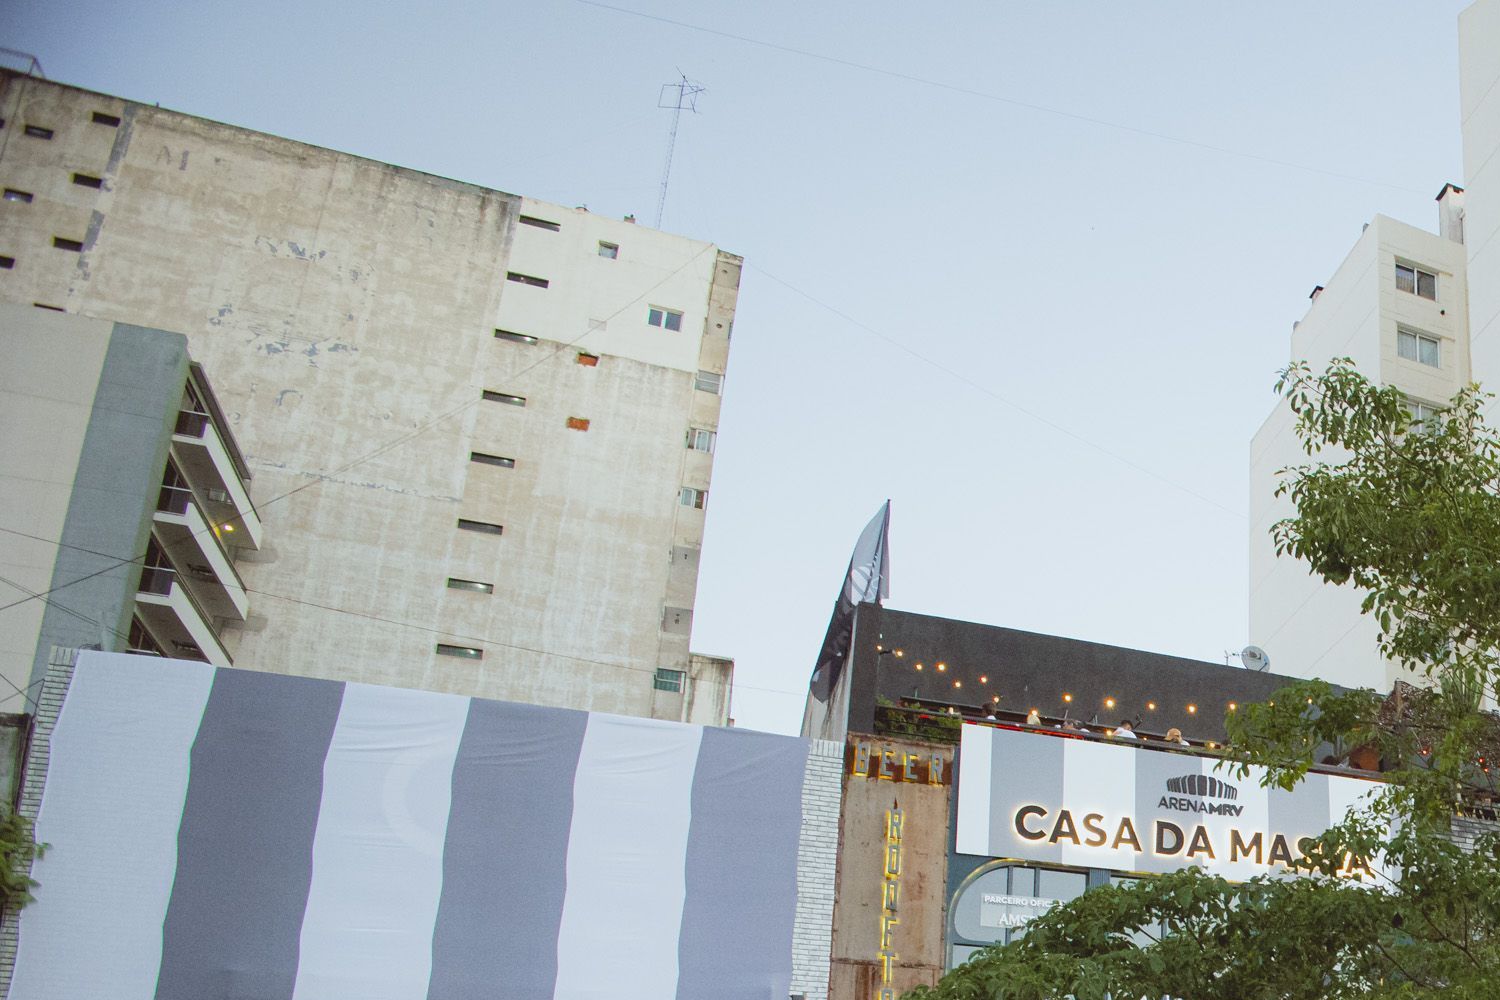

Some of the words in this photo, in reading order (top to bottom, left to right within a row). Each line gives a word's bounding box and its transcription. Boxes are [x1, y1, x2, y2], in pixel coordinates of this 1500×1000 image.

[853, 741, 944, 787] BEER
[1014, 804, 1142, 852] CASA
[1155, 820, 1216, 859] DA
[984, 894, 1029, 907] PARCEIRO
